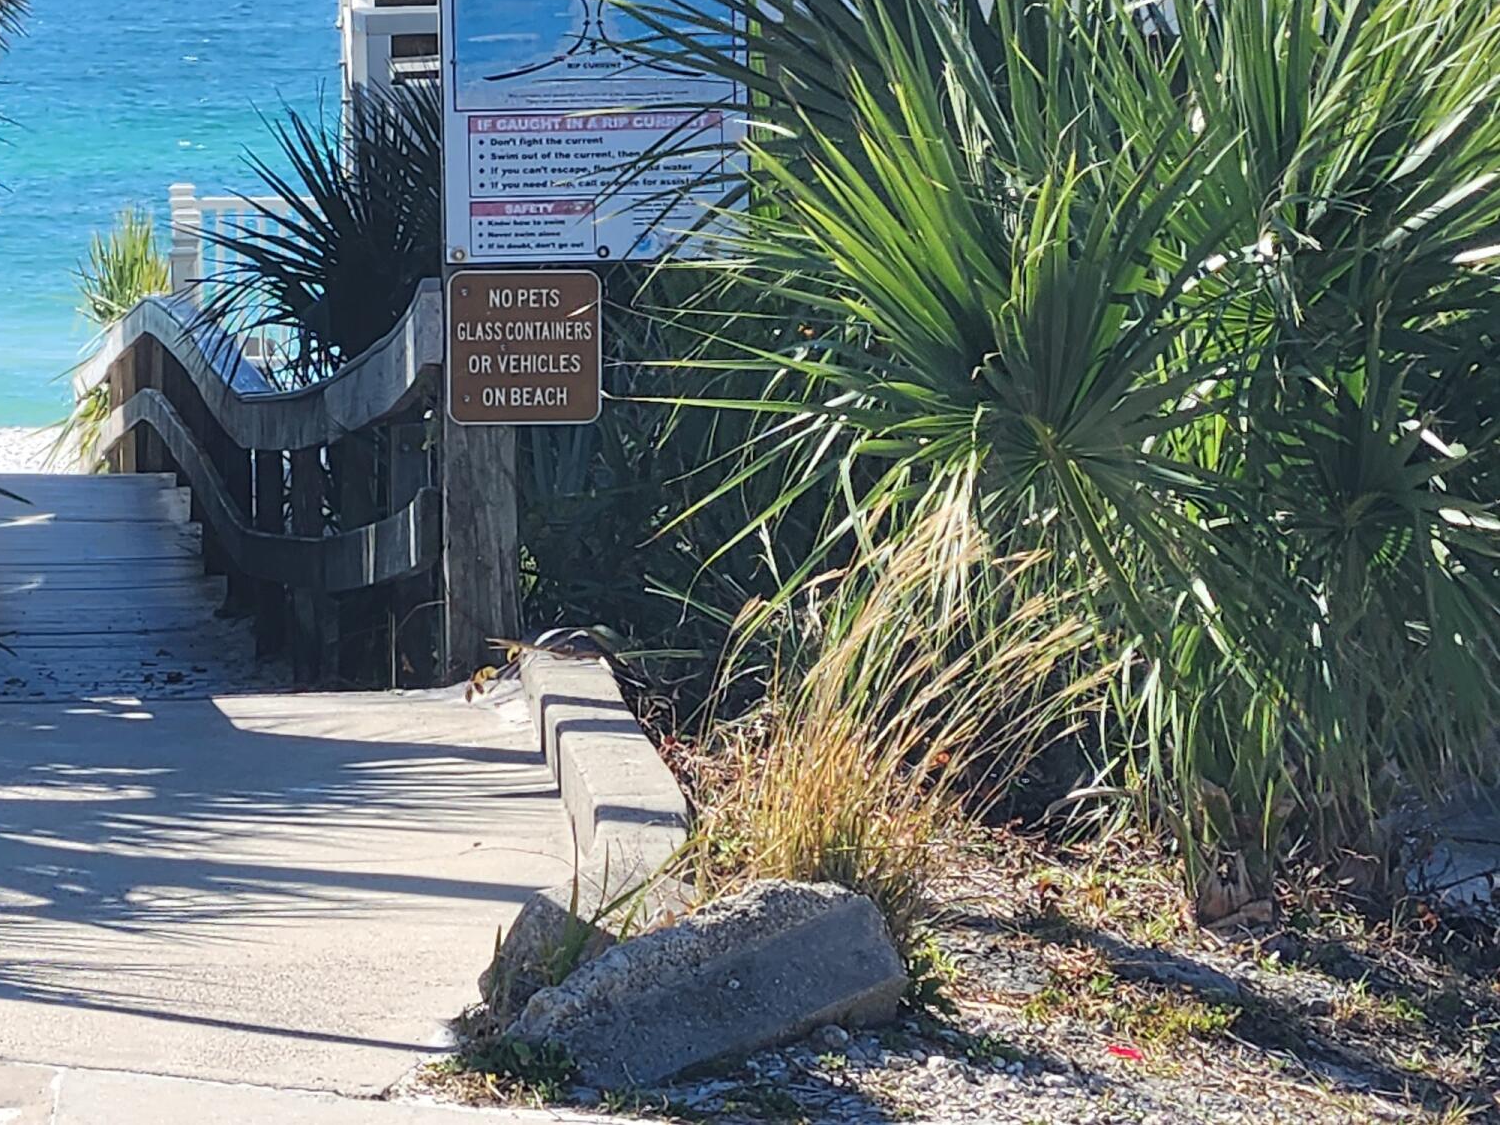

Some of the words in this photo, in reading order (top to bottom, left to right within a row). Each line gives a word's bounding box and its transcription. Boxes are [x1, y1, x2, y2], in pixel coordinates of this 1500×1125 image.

[477, 119, 492, 131] IF
[496, 118, 562, 131] CAUGHT
[566, 117, 584, 130] IN
[586, 117, 598, 129] A
[602, 117, 629, 129] RIP
[490, 138, 516, 146] Don't
[519, 137, 543, 147] fight
[546, 137, 562, 145] the
[565, 136, 603, 145] current
[490, 152, 518, 160] Swim
[522, 152, 538, 160] out
[541, 151, 551, 160] of
[554, 151, 571, 159] the
[618, 150, 640, 158] then
[490, 166, 498, 175] If
[501, 167, 519, 177] you
[522, 166, 547, 175] can't
[490, 181, 498, 189] If
[501, 181, 519, 190] you
[522, 180, 548, 188] need
[578, 179, 597, 187] call
[643, 178, 657, 186] for
[504, 203, 555, 214] SAFETY
[488, 288, 512, 308] NO
[517, 288, 560, 308] PETS
[457, 322, 502, 341] GLASS
[505, 321, 592, 341] CONTAINERS
[468, 354, 491, 374] OR
[497, 354, 581, 374] VEHICLES
[482, 387, 505, 407] ON
[510, 386, 568, 406] BEACH
